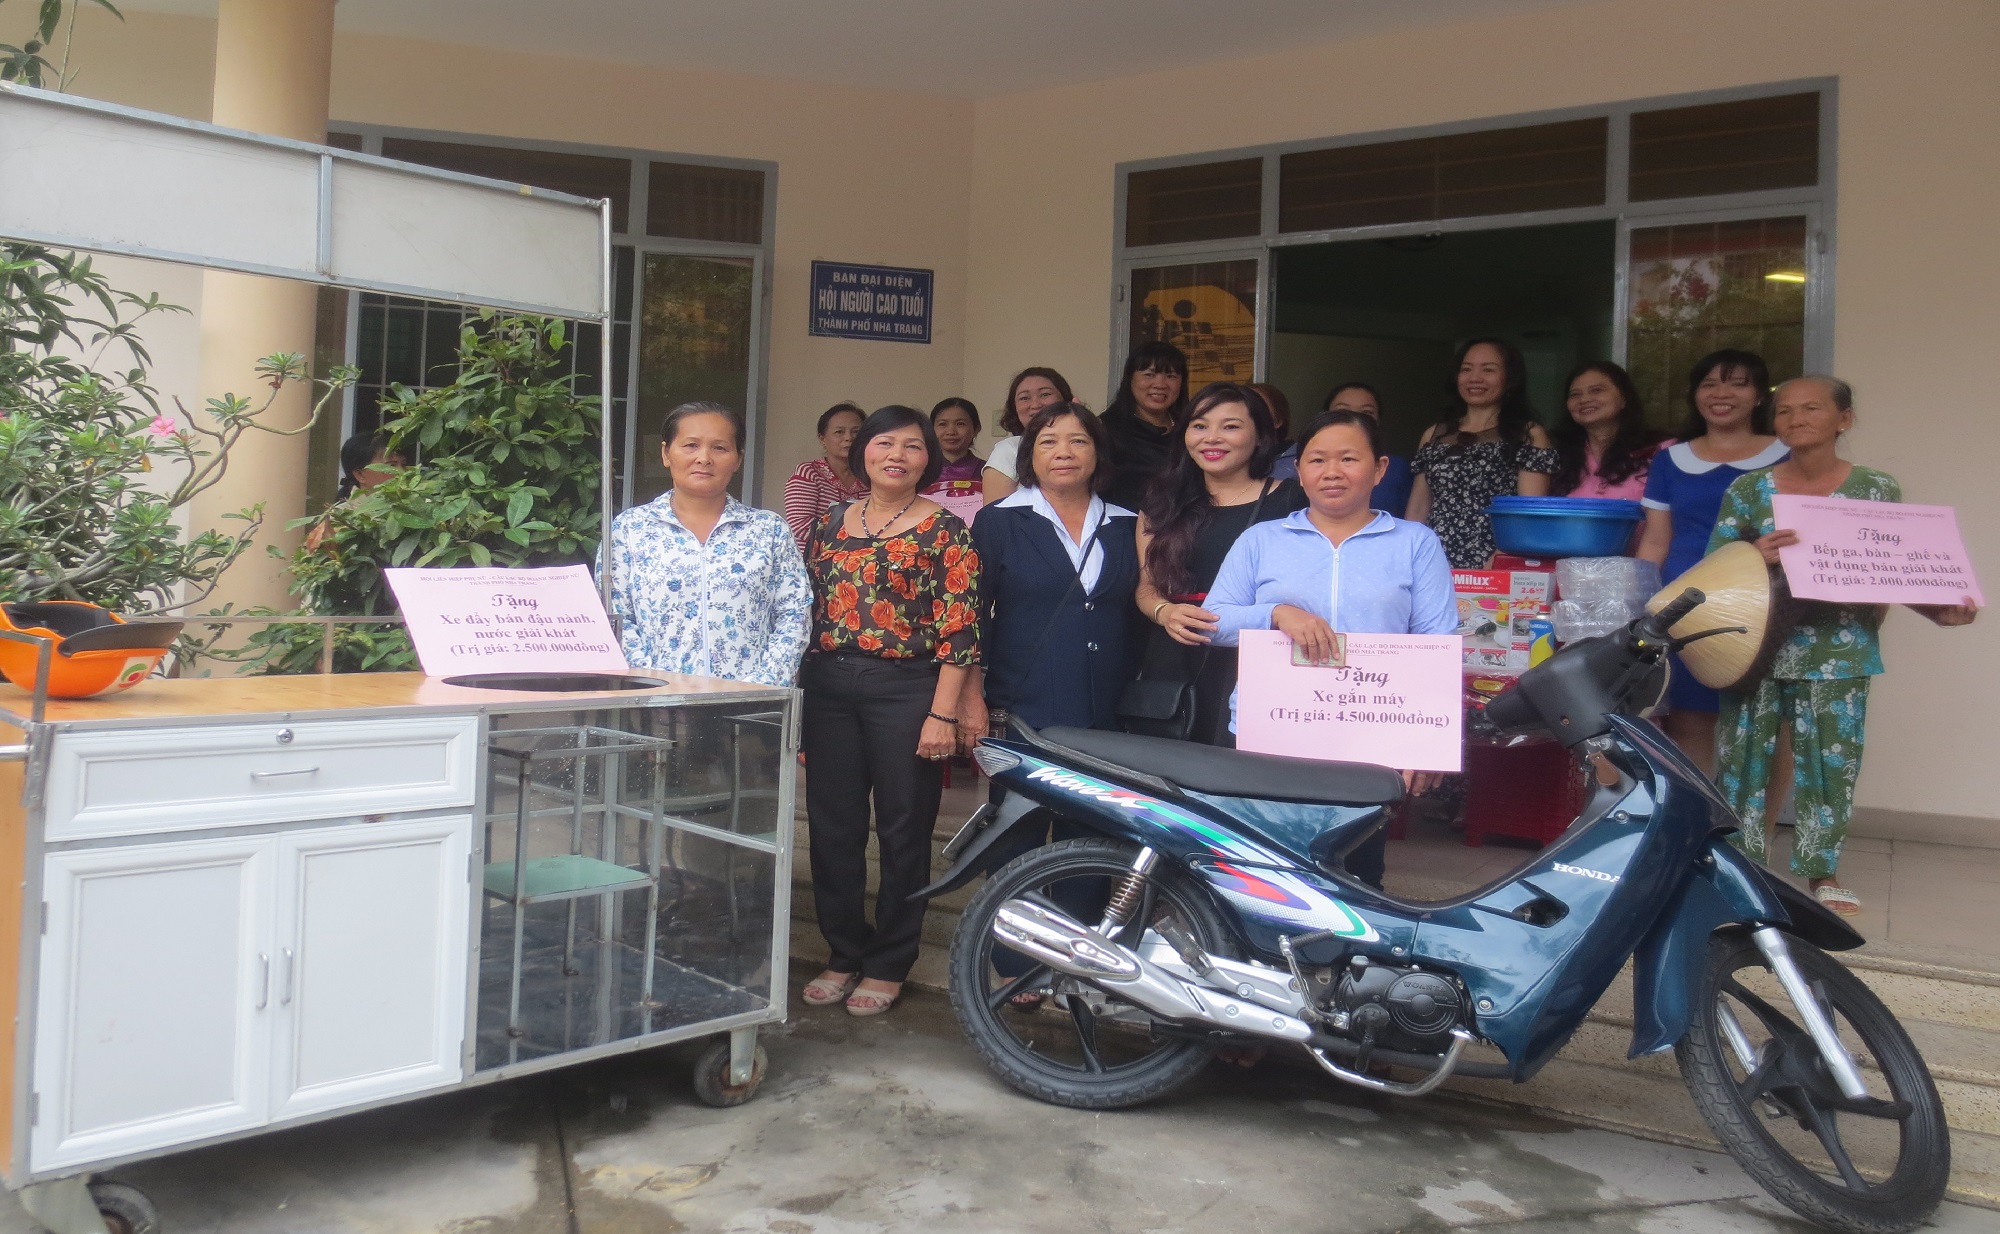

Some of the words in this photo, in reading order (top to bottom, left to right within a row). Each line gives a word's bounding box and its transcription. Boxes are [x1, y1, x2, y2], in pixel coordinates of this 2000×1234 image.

[833, 271, 857, 284] BAN
[861, 274, 881, 288] ĐẠI
[885, 275, 913, 290] DIỆN
[818, 284, 837, 315] HỘI
[840, 286, 874, 314] NGƯỜI
[876, 293, 898, 315] CAO
[901, 287, 924, 317] TUỔI
[818, 315, 848, 329] THÀNH
[851, 318, 872, 331] PHỐ
[873, 321, 891, 333] NHA
[894, 323, 923, 335] TRANG
[1857, 527, 1902, 546] Tặng
[1813, 543, 1838, 557] Bếp
[1906, 548, 1930, 562] ghế
[1809, 559, 1830, 571] vật
[1834, 559, 1869, 573] dụng
[1871, 561, 1897, 572] bán
[1901, 563, 1927, 575] giải
[1929, 564, 1964, 574] khát
[1451, 574, 1489, 586] Milux
[1812, 573, 1838, 586] (Trị
[1841, 574, 1866, 586] giá:
[491, 593, 540, 610] Tặng
[440, 614, 461, 625] Xe
[466, 611, 491, 627] đẩy
[495, 613, 523, 625] bán
[527, 613, 553, 626] đậu
[555, 613, 596, 625] nành,
[474, 628, 512, 639] nước
[516, 628, 541, 641] giải
[545, 628, 577, 639] khát
[450, 643, 480, 657] (Trị
[484, 642, 510, 655] giá:
[512, 640, 611, 655] 2.500.000đồng)
[1335, 665, 1390, 688] Tặng
[1313, 690, 1334, 703] Xe
[1338, 688, 1367, 706] gắn
[1373, 691, 1407, 708] máy
[1270, 707, 1299, 722] (Trị
[1304, 710, 1331, 724] giá:
[1336, 709, 1450, 728] 4.500.000đồng)
[1552, 862, 1621, 883] HONDA
